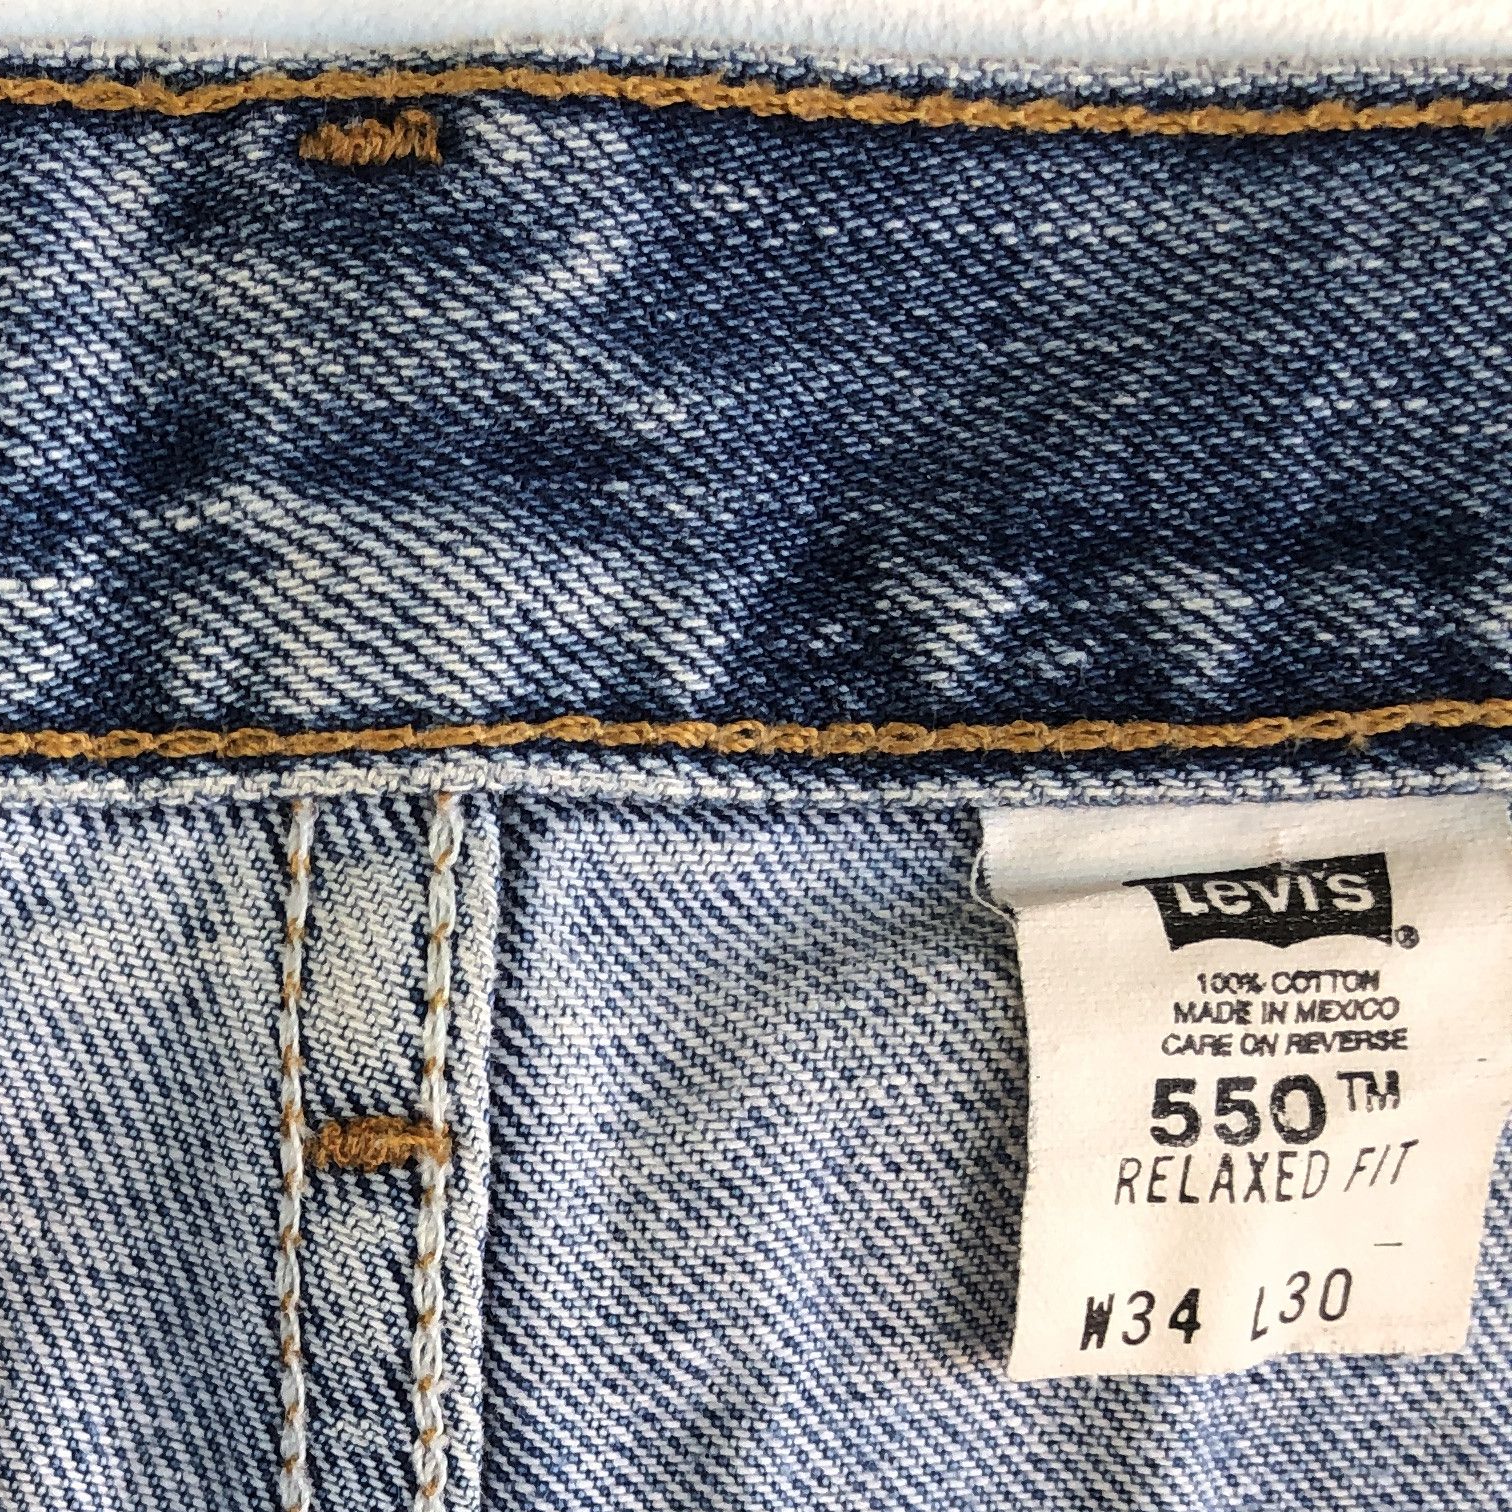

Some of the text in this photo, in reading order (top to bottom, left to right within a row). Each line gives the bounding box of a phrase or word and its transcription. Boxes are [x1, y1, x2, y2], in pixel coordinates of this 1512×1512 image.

[1196, 969, 1381, 994] 100% COTTON
[1173, 996, 1400, 1025] MADE IN MEXICO
[1161, 1027, 1409, 1057] CARE ON REVERSE
[1114, 1138, 1420, 1206] RELAXED FIT
[1079, 1267, 1354, 1351] W34 L30
